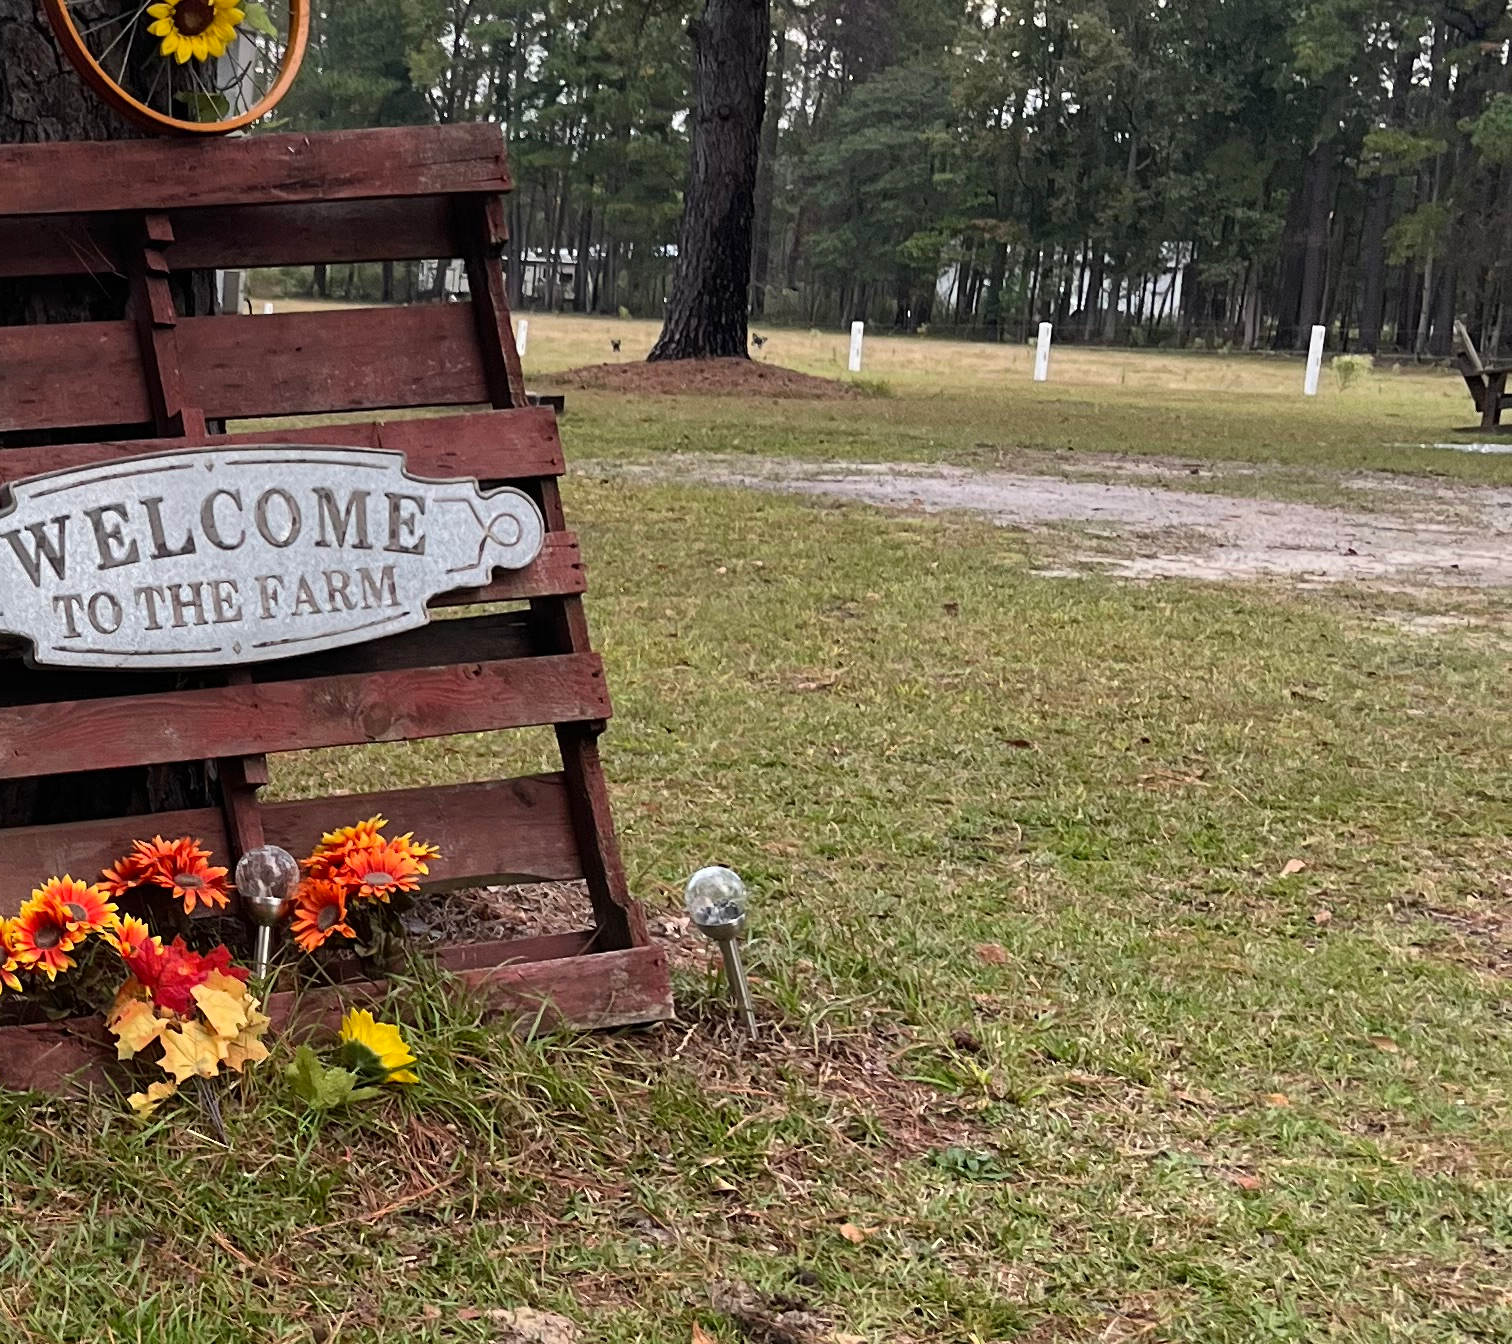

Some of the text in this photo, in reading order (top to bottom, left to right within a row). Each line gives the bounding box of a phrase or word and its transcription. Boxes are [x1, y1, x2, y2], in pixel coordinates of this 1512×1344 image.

[0, 486, 427, 588] WELCOME
[51, 564, 402, 639] TO THE FARM
